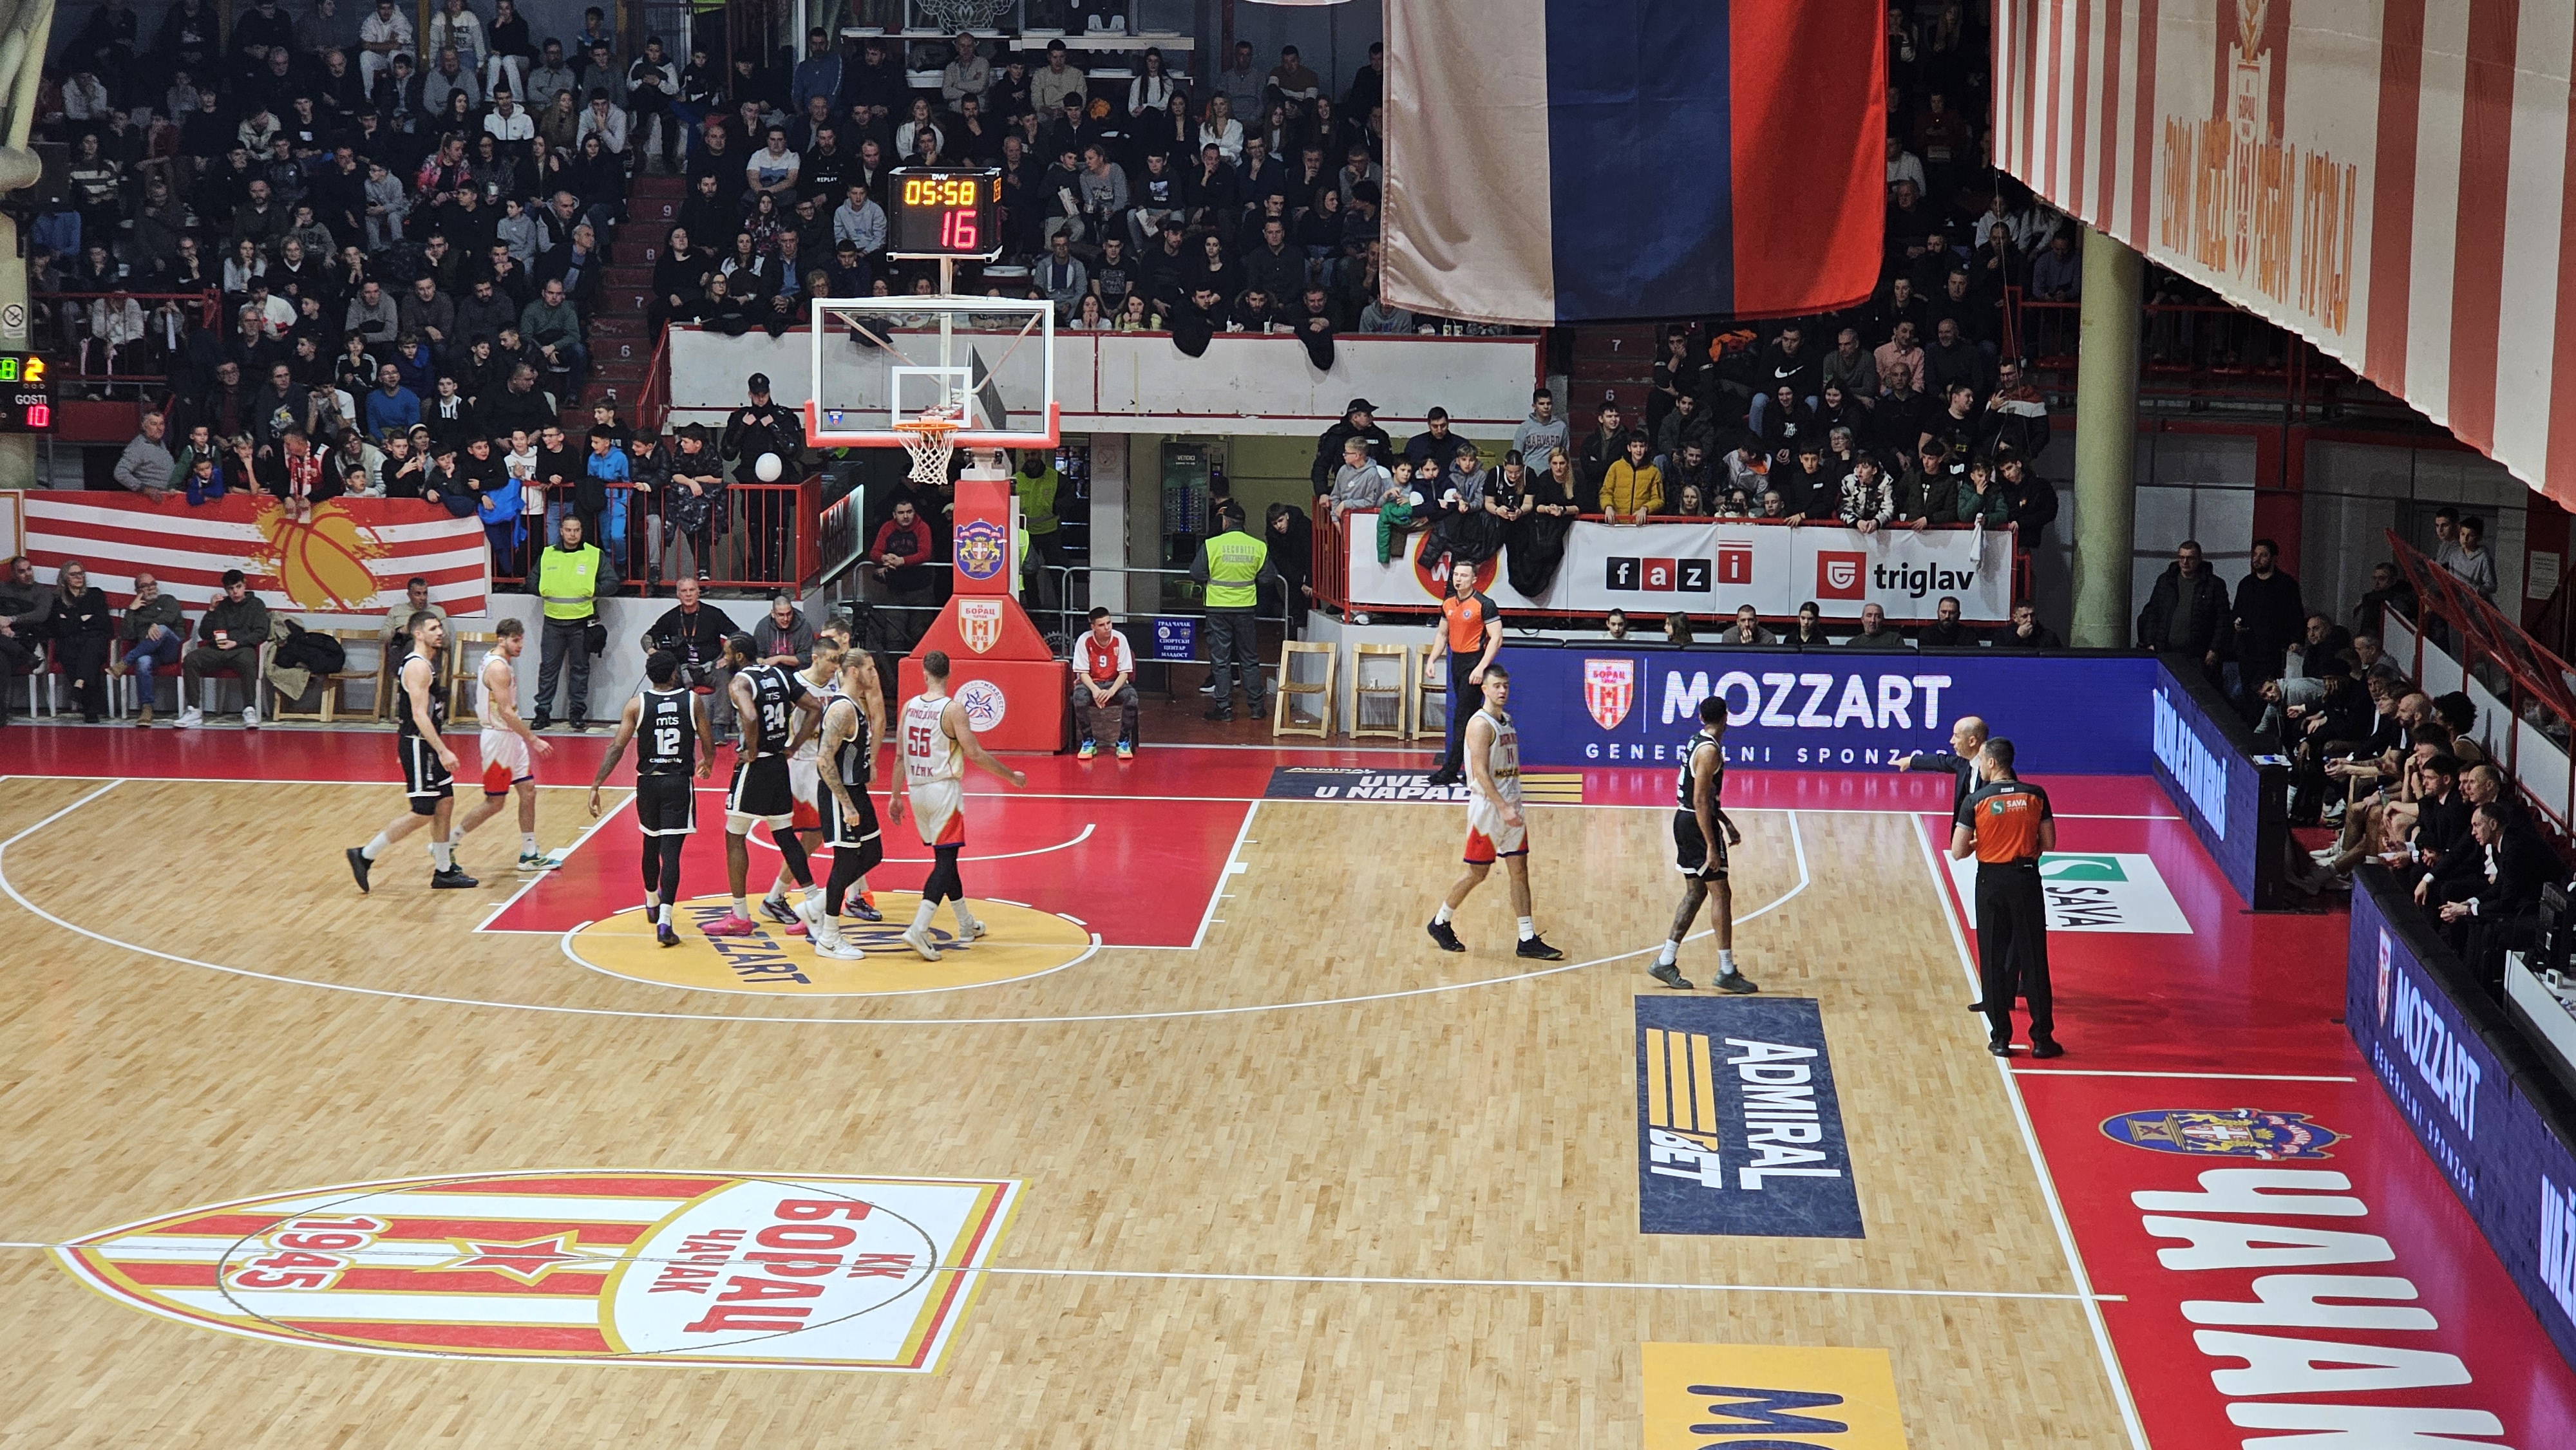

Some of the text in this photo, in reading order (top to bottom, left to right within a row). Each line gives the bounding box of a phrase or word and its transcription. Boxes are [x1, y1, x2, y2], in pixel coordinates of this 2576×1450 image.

[905, 180, 975, 205] 05:58
[663, 205, 672, 216] 9
[941, 209, 977, 249] 16
[635, 296, 643, 308] 7
[620, 345, 630, 357] 6
[1612, 339, 1622, 352] 7
[24, 357, 45, 382] 2
[15, 394, 47, 404] GOSTI
[1605, 390, 1615, 401] 6
[26, 404, 50, 427] 10
[828, 500, 844, 537] FAN
[1222, 545, 1255, 554] SECURITY
[1615, 554, 1740, 588] fazi
[1873, 562, 1975, 599] triglav
[1099, 655, 1107, 668] 9
[1662, 670, 1952, 730] MOZZART
[656, 715, 679, 726] mts
[762, 702, 786, 731] 24
[654, 728, 681, 755] 12
[908, 726, 932, 758] 55
[1586, 742, 1948, 765] GENERLNI SPONZ
[1315, 787, 1340, 798] U
[2006, 799, 2027, 807] SAVA
[2045, 887, 2126, 927] SAVA
[2394, 966, 2481, 1142] MOZZART
[1725, 1037, 1842, 1191] ADMIRAL
[2374, 1040, 2476, 1201] GENERALNI SPONZOR
[234, 1217, 379, 1289] 1945
[647, 1229, 747, 1294] ЧАЧАК
[683, 1199, 875, 1333] БОРАЦ
[846, 1253, 916, 1279] КК
[2130, 1168, 2515, 1450] ЧАЧАК
[1686, 1384, 1850, 1450] M
